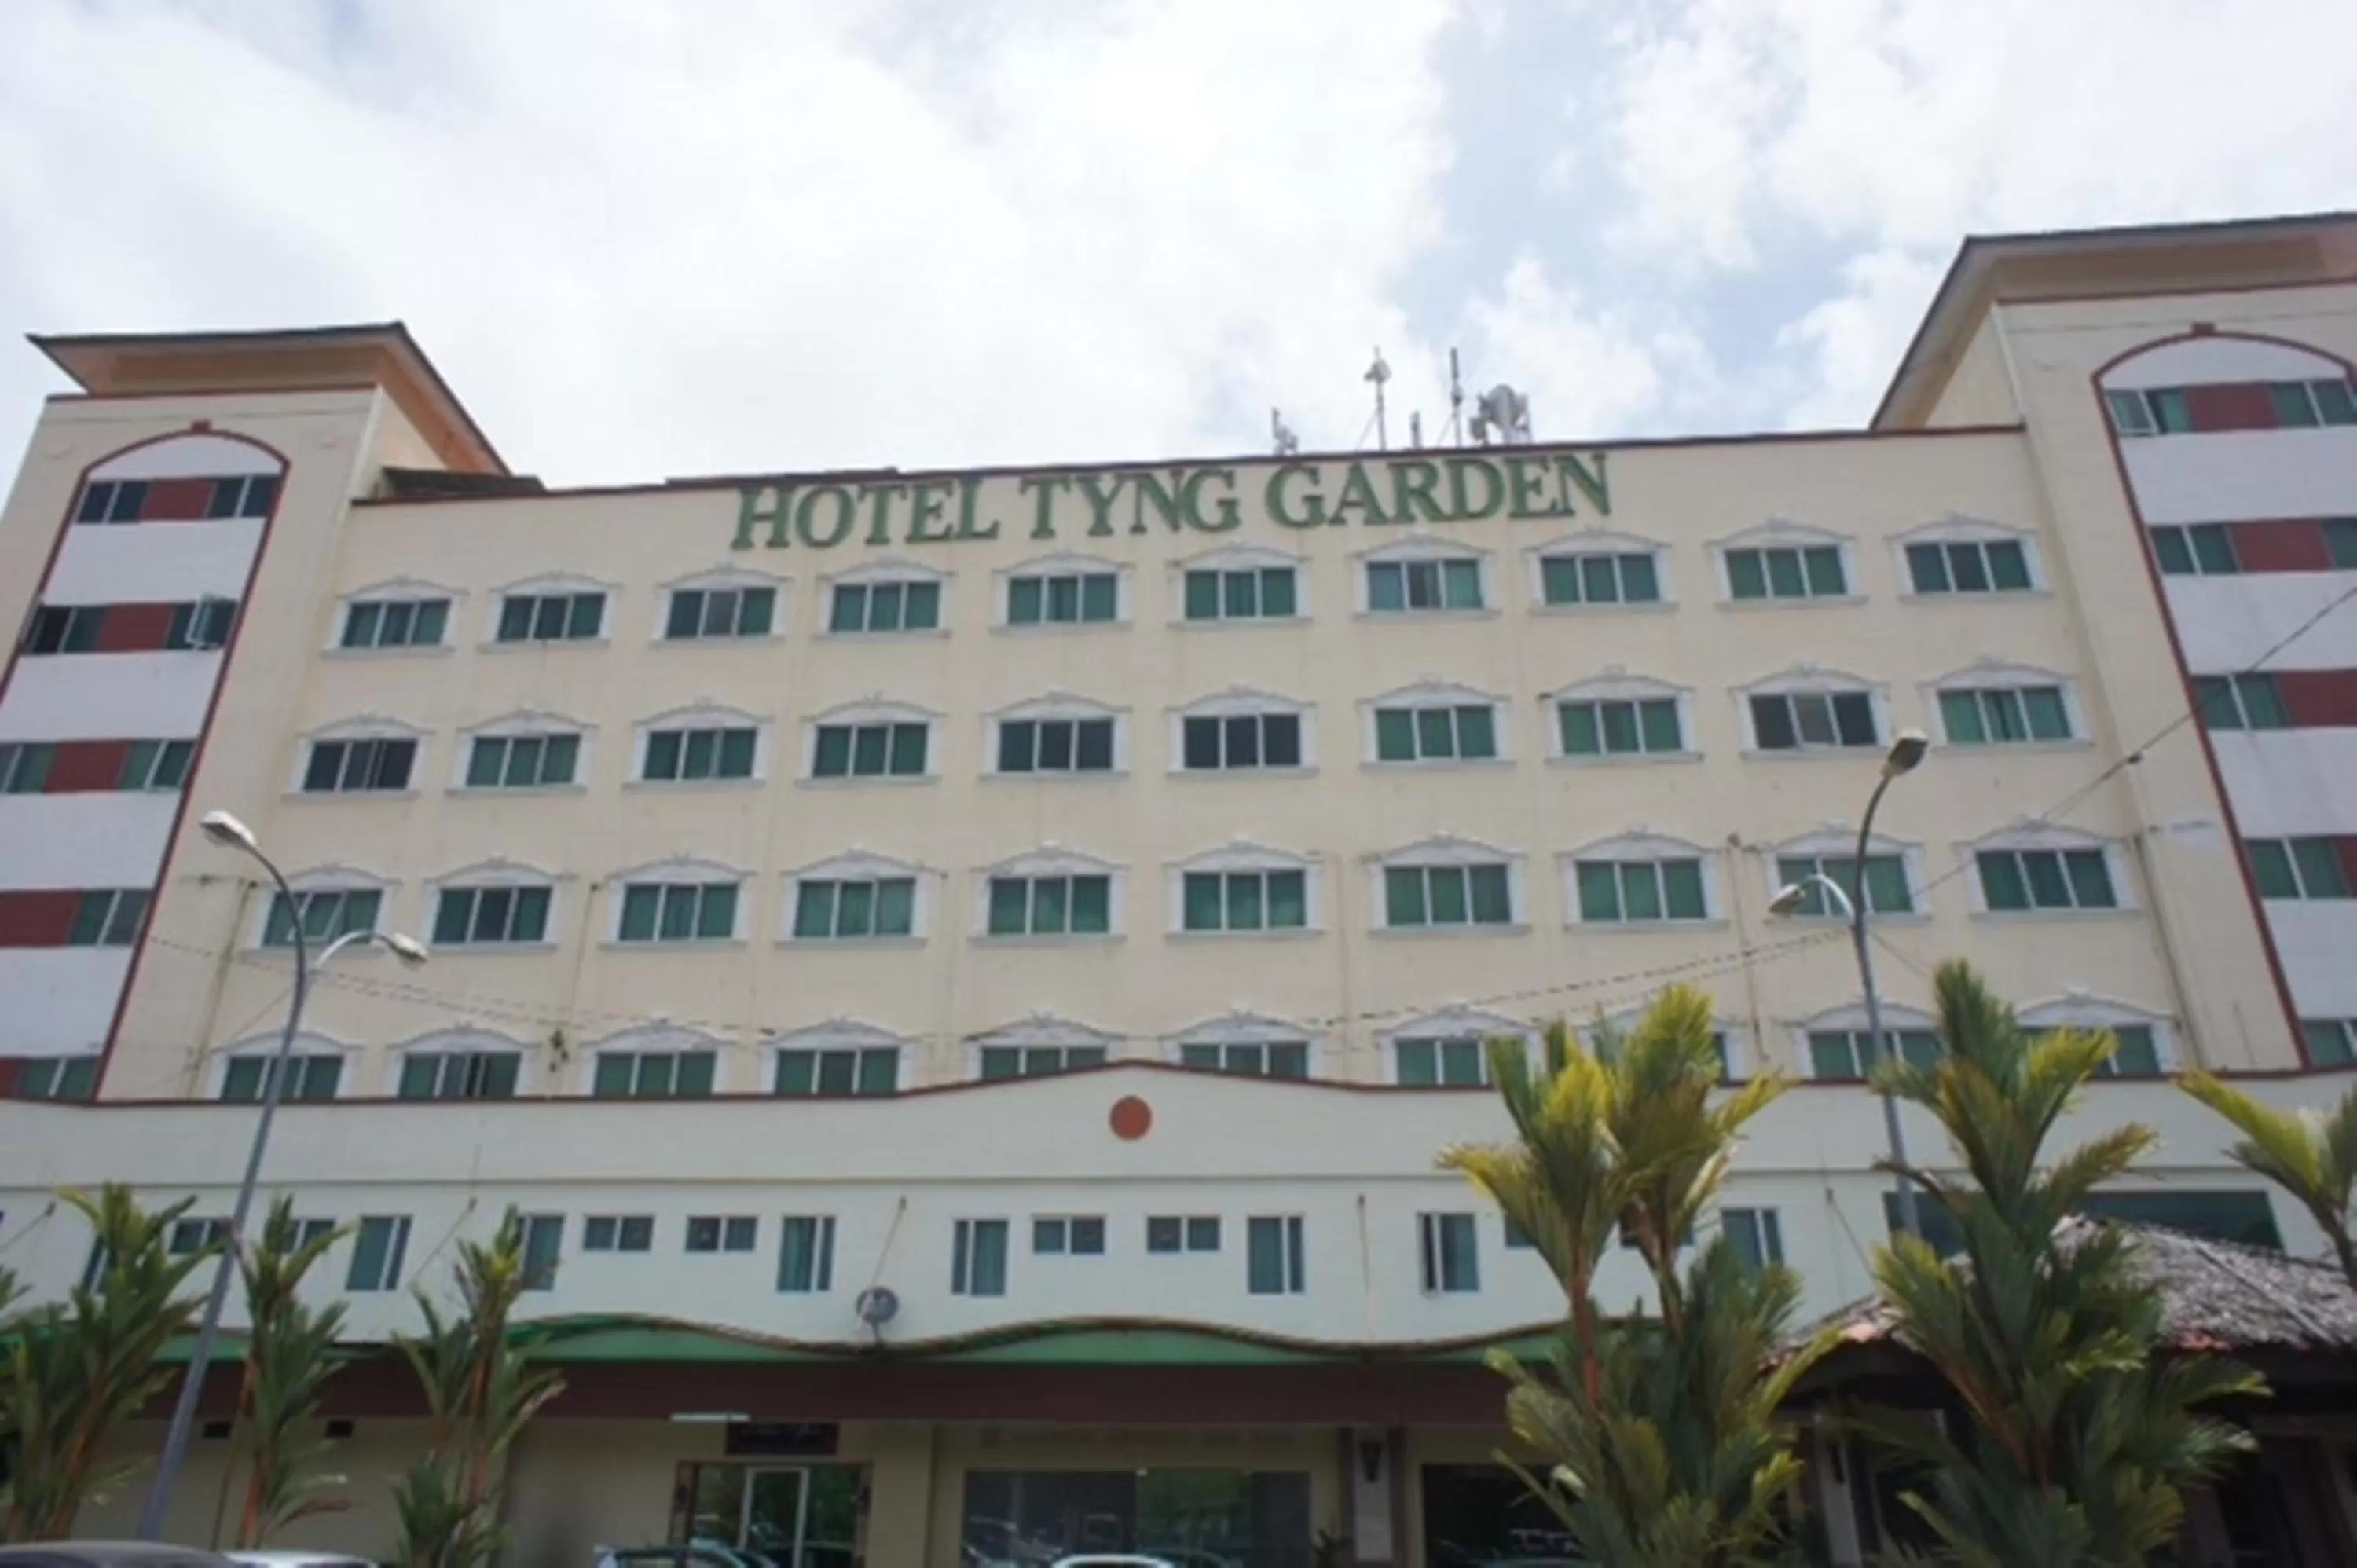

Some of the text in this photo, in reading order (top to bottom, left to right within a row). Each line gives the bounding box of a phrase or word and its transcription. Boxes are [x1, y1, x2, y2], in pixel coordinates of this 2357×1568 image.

[731, 452, 1611, 551] HOTEL TYNG GARDEN
